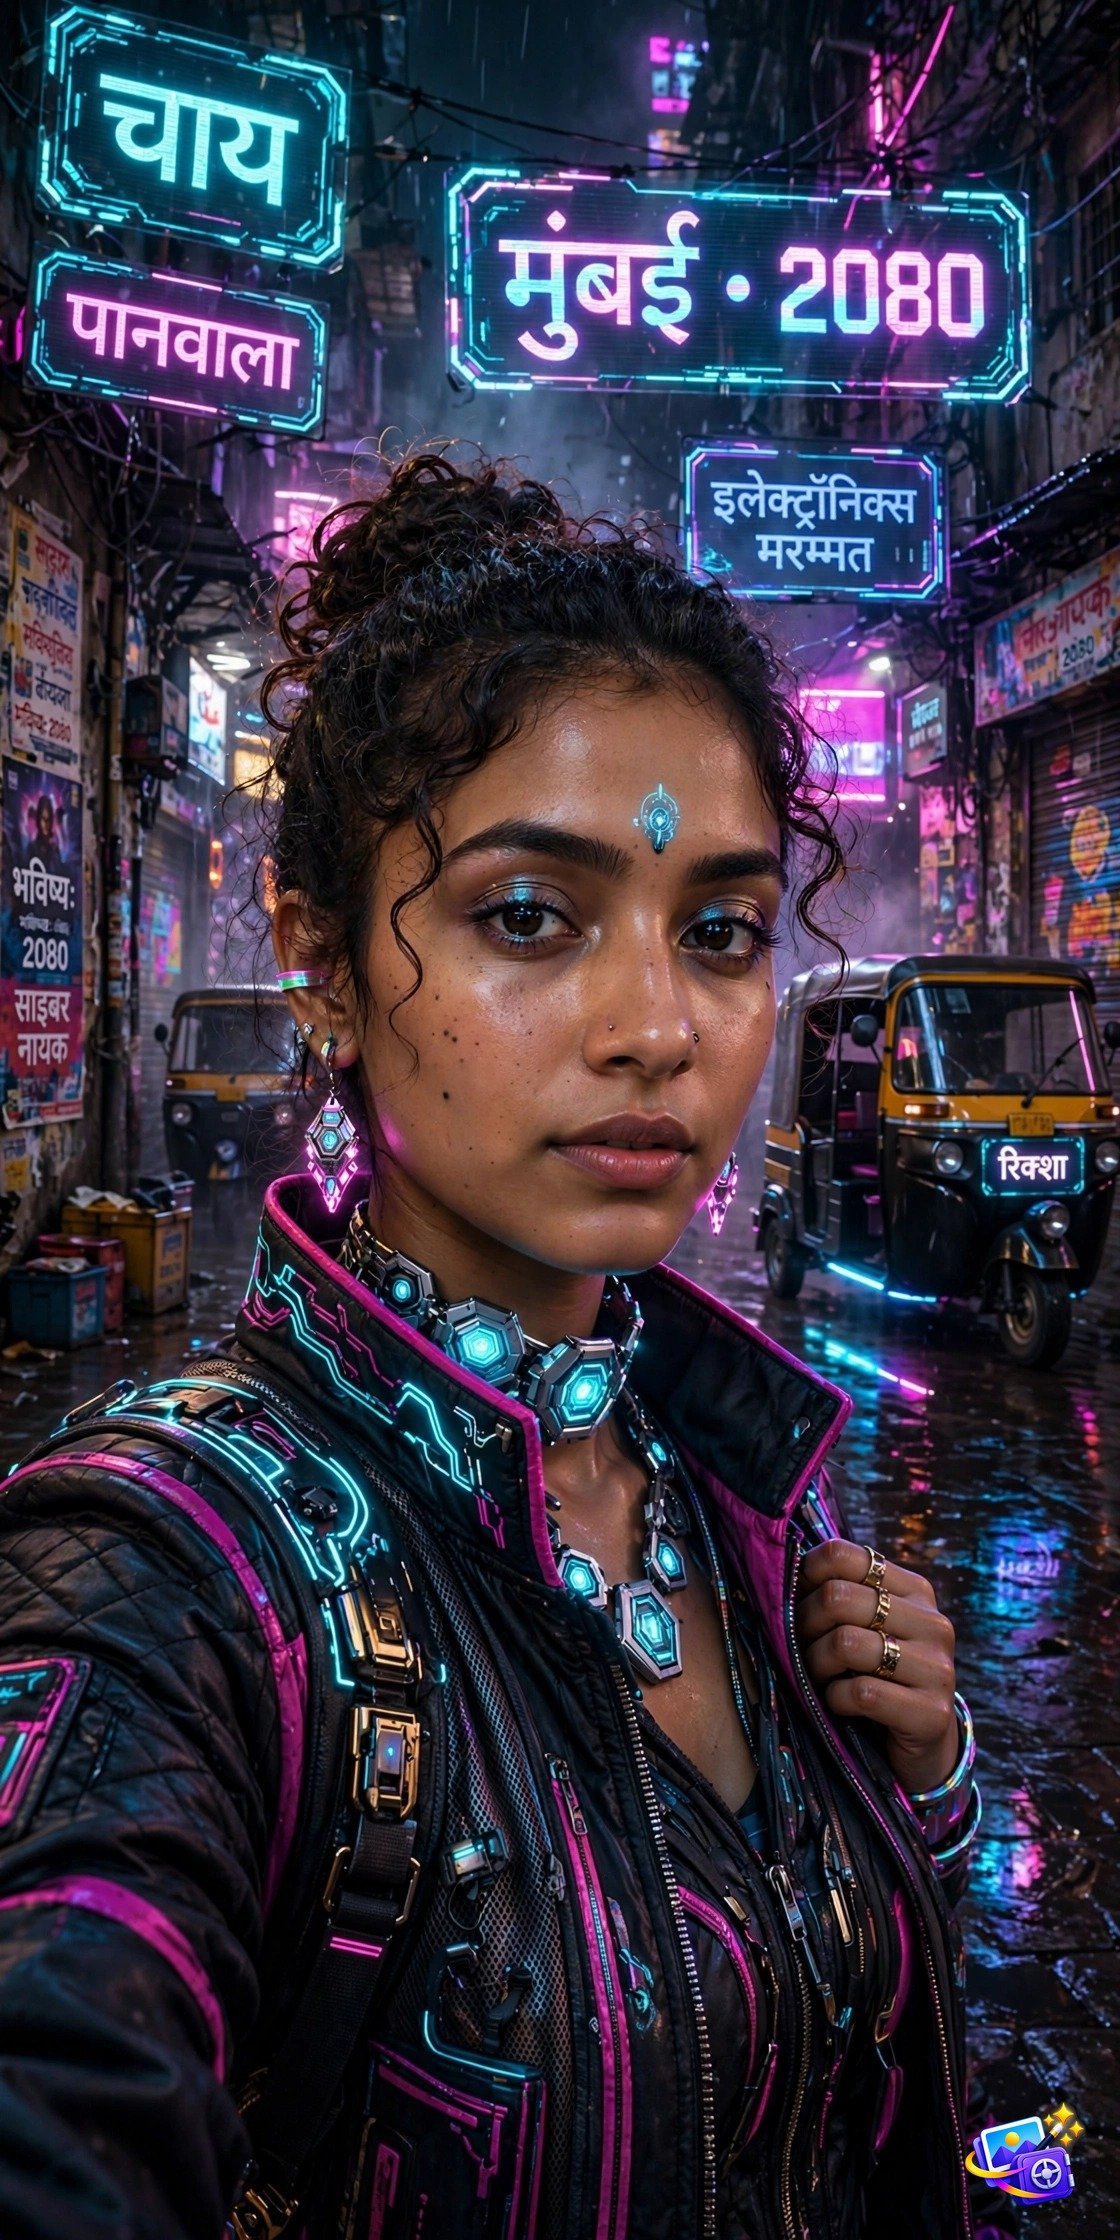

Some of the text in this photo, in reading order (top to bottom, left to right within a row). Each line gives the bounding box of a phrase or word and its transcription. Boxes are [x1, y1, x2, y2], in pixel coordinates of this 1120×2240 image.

[99, 73, 300, 207] चाय
[497, 210, 701, 362] मुंबई
[779, 245, 986, 339] 2080
[65, 293, 301, 390] पानवाला
[709, 469, 918, 530] इलेक्ट्रॉनिक्स
[755, 534, 875, 573] मरम्मत
[22, 936, 69, 972] 2080
[14, 989, 71, 1028] साइबर
[17, 1033, 69, 1066] नायक
[997, 1145, 1069, 1181] रिक्शा
